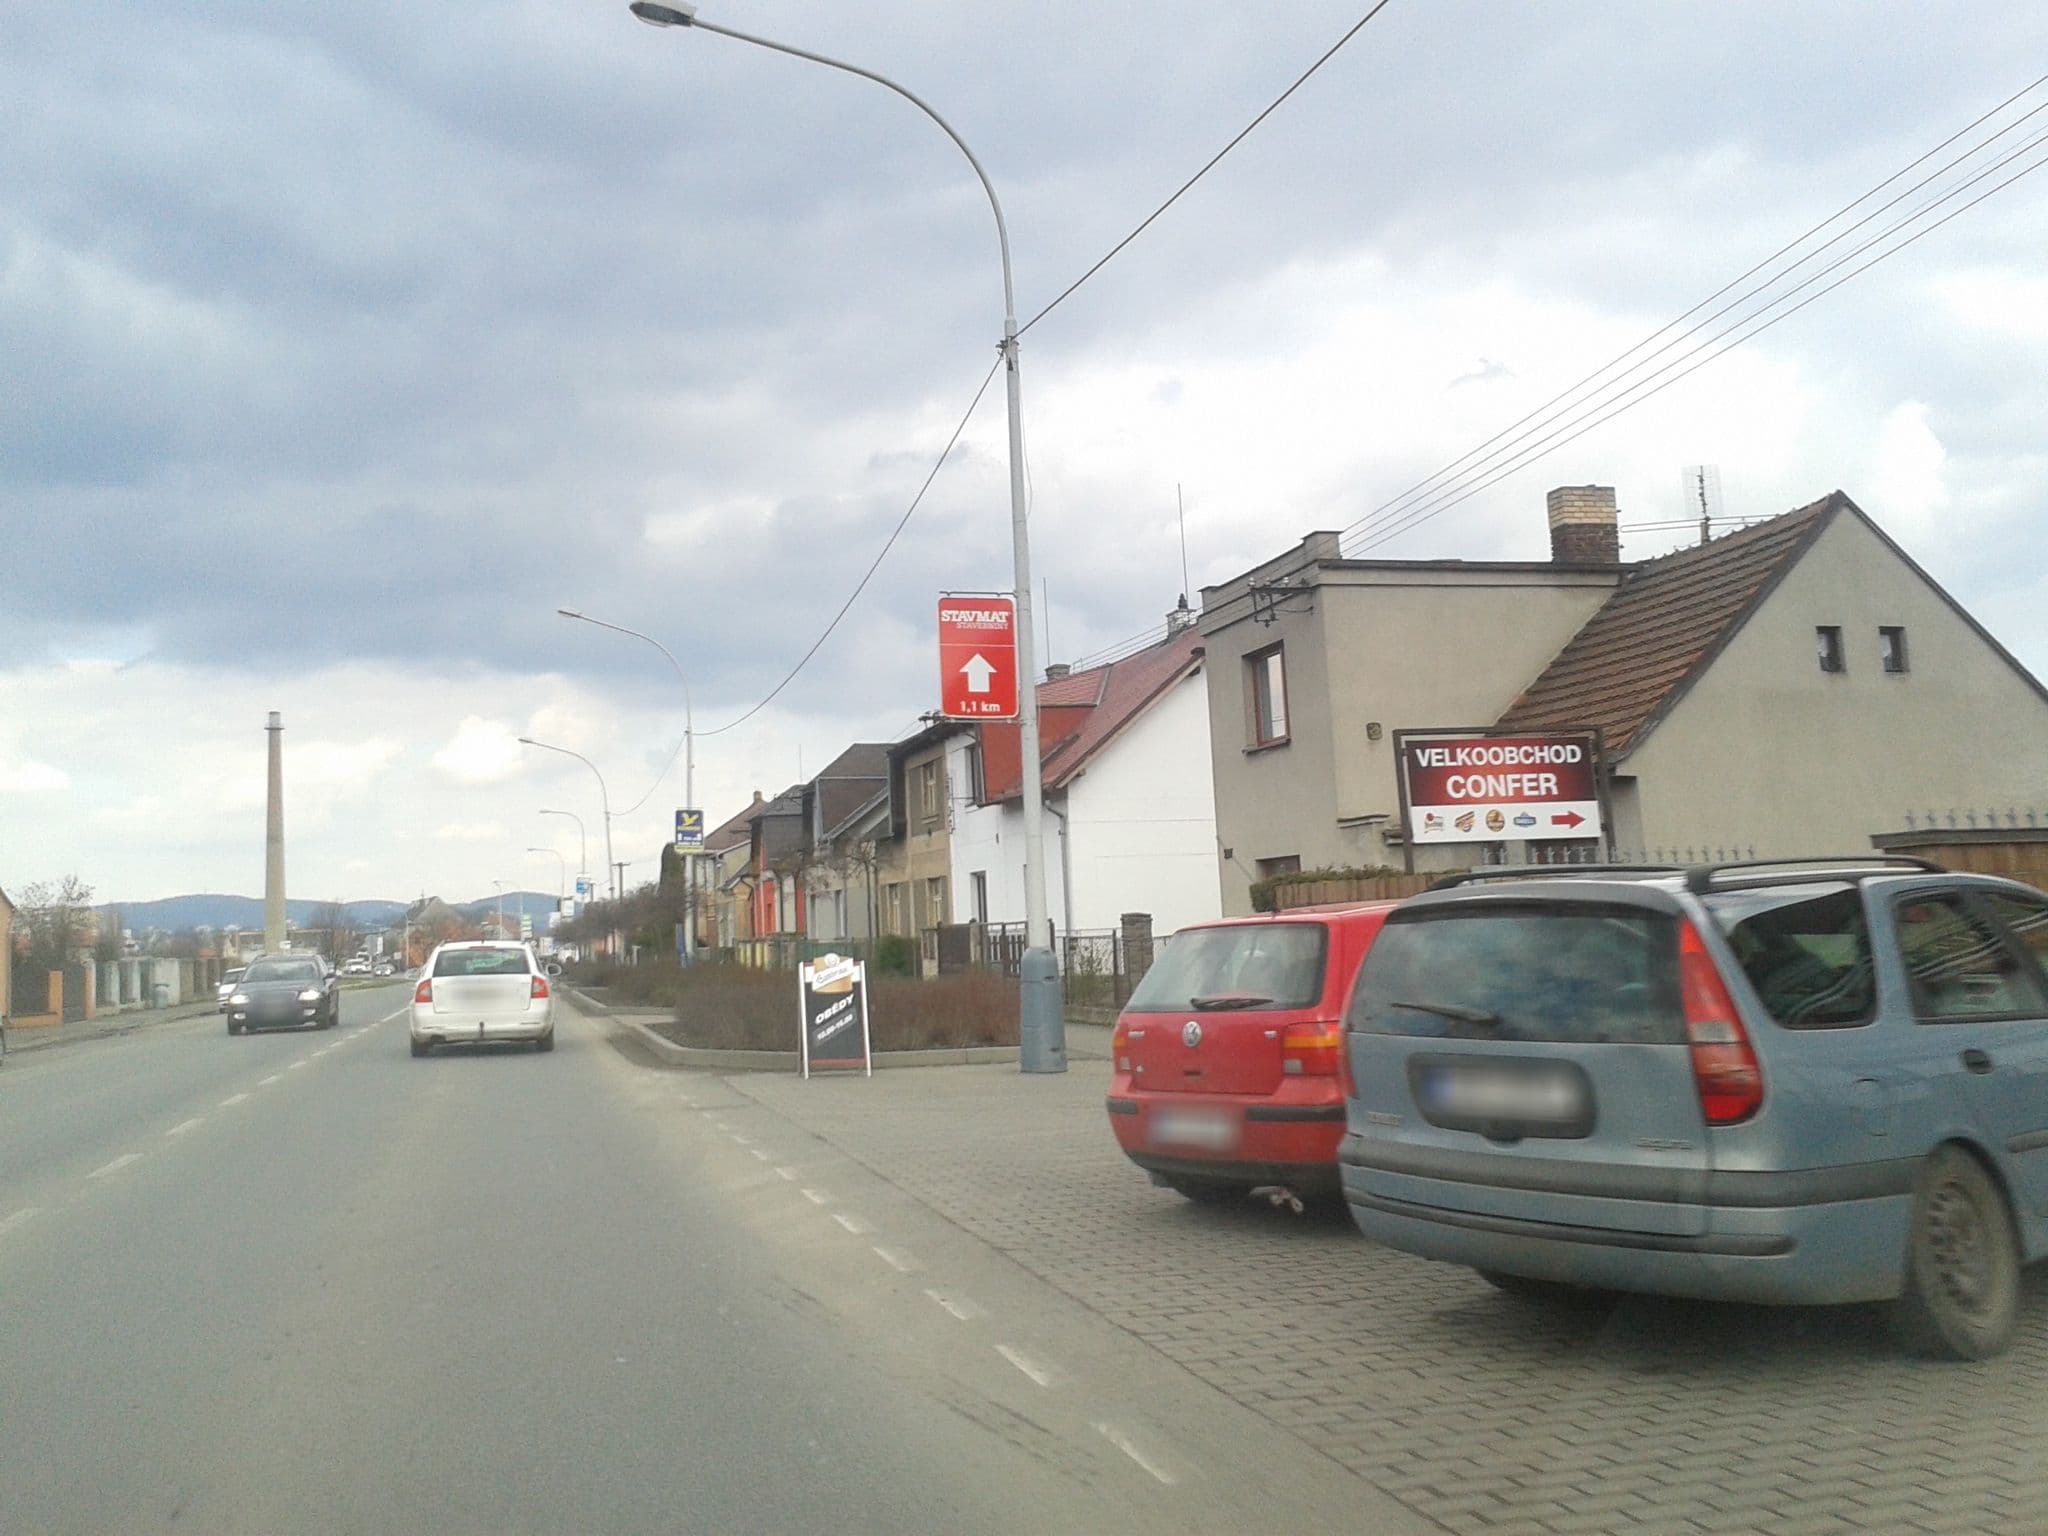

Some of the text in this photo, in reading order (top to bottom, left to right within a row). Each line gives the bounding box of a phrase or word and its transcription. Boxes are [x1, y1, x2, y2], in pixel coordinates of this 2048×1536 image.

[941, 610, 1009, 622] STAVMAT
[960, 700, 1001, 714] 1,1 km
[1415, 744, 1582, 767] VELKOOBCHOD
[1446, 772, 1560, 799] CONFER
